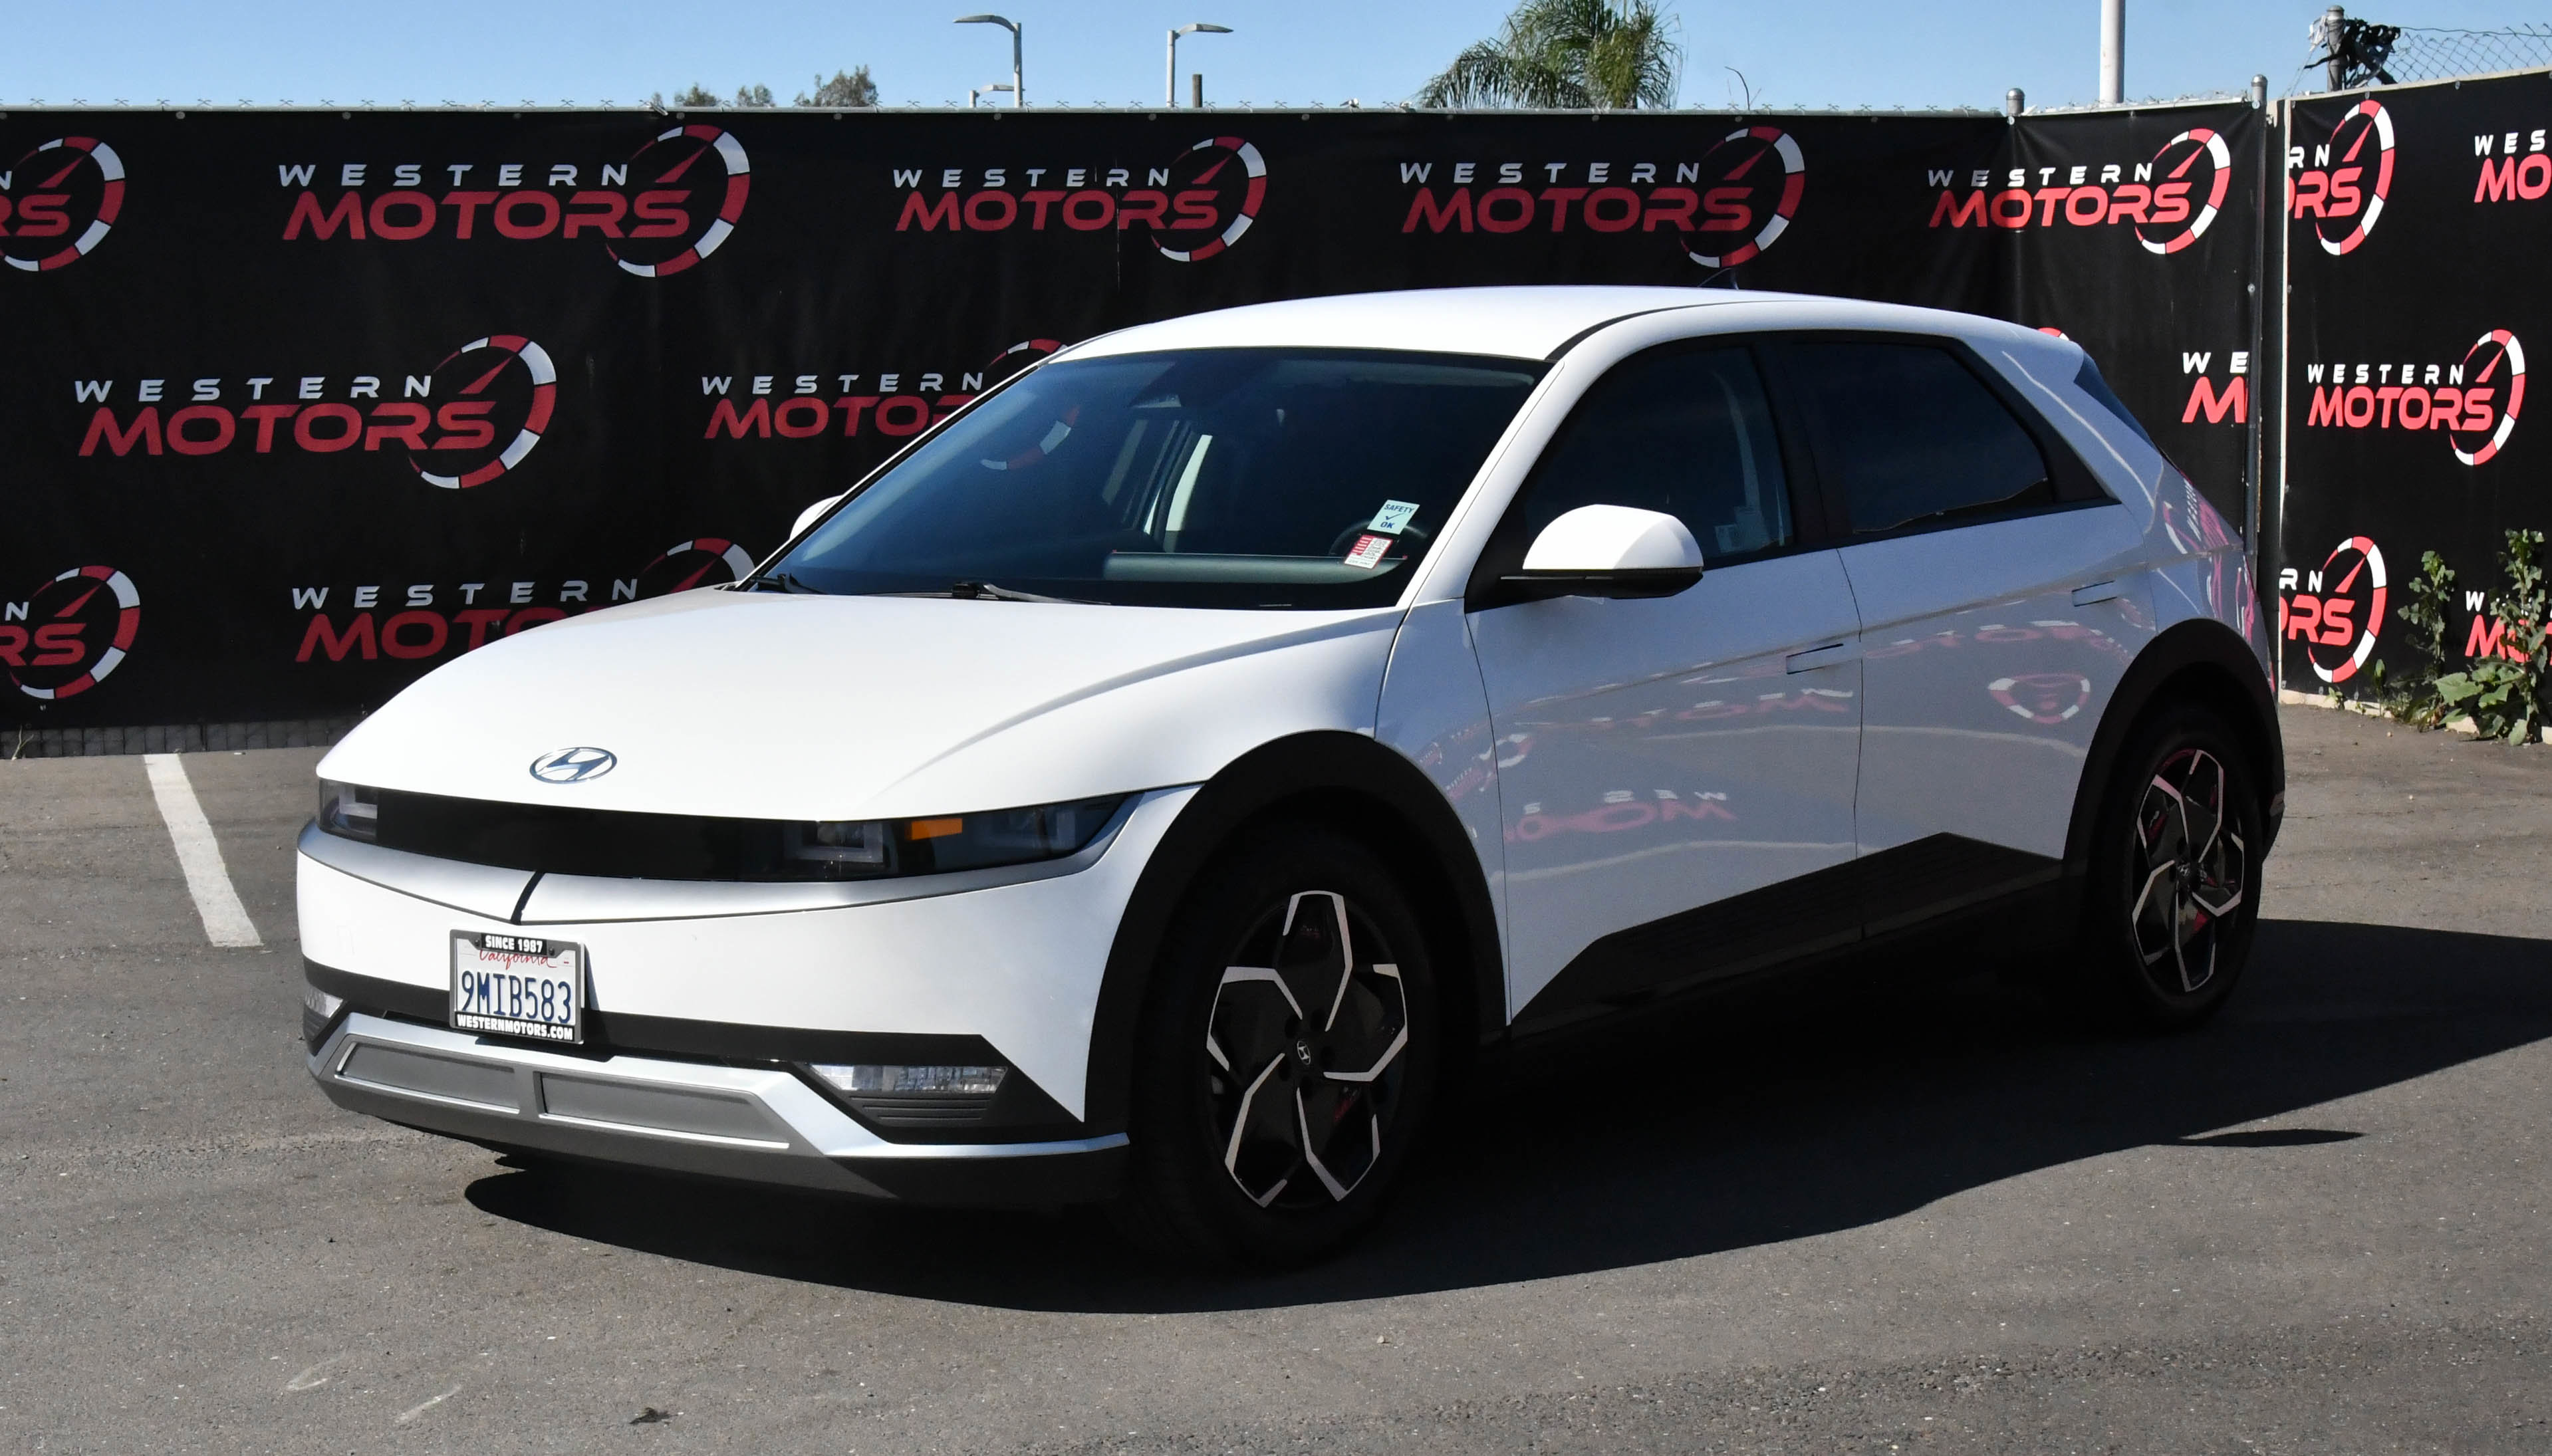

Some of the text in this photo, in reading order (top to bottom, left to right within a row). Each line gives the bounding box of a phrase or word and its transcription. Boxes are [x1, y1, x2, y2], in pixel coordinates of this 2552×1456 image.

[2474, 129, 2546, 156] WES
[279, 164, 628, 187] WESTERN
[894, 168, 1169, 188] WESTERN
[1400, 163, 1699, 183] WESTERN
[1928, 162, 2153, 187] WESTERN
[2474, 153, 2552, 203] MO
[1929, 181, 2193, 228] MOTORS
[2289, 166, 2364, 219] RS
[283, 190, 691, 240] MOTORS
[895, 189, 1219, 231] MOTORS
[1402, 187, 1753, 233] MOTORS
[2182, 351, 2249, 374] WE
[2307, 363, 2464, 385] WESTERN
[75, 375, 432, 403] WESTERN
[702, 372, 983, 395] WESTERN
[2181, 375, 2249, 424] M
[2307, 384, 2495, 433] MOTORS
[78, 401, 496, 456] MOTORS
[1384, 504, 1414, 514] SAFETY
[1380, 521, 1395, 529] OK
[293, 578, 638, 610] WESTERN
[2279, 567, 2323, 593] RN
[2279, 594, 2356, 647] RS
[295, 608, 567, 662] MOT
[485, 935, 543, 953] SINCE 1987
[461, 970, 572, 1024] 9MIB583
[457, 1014, 574, 1040] WESTERNMOTORS.COM
